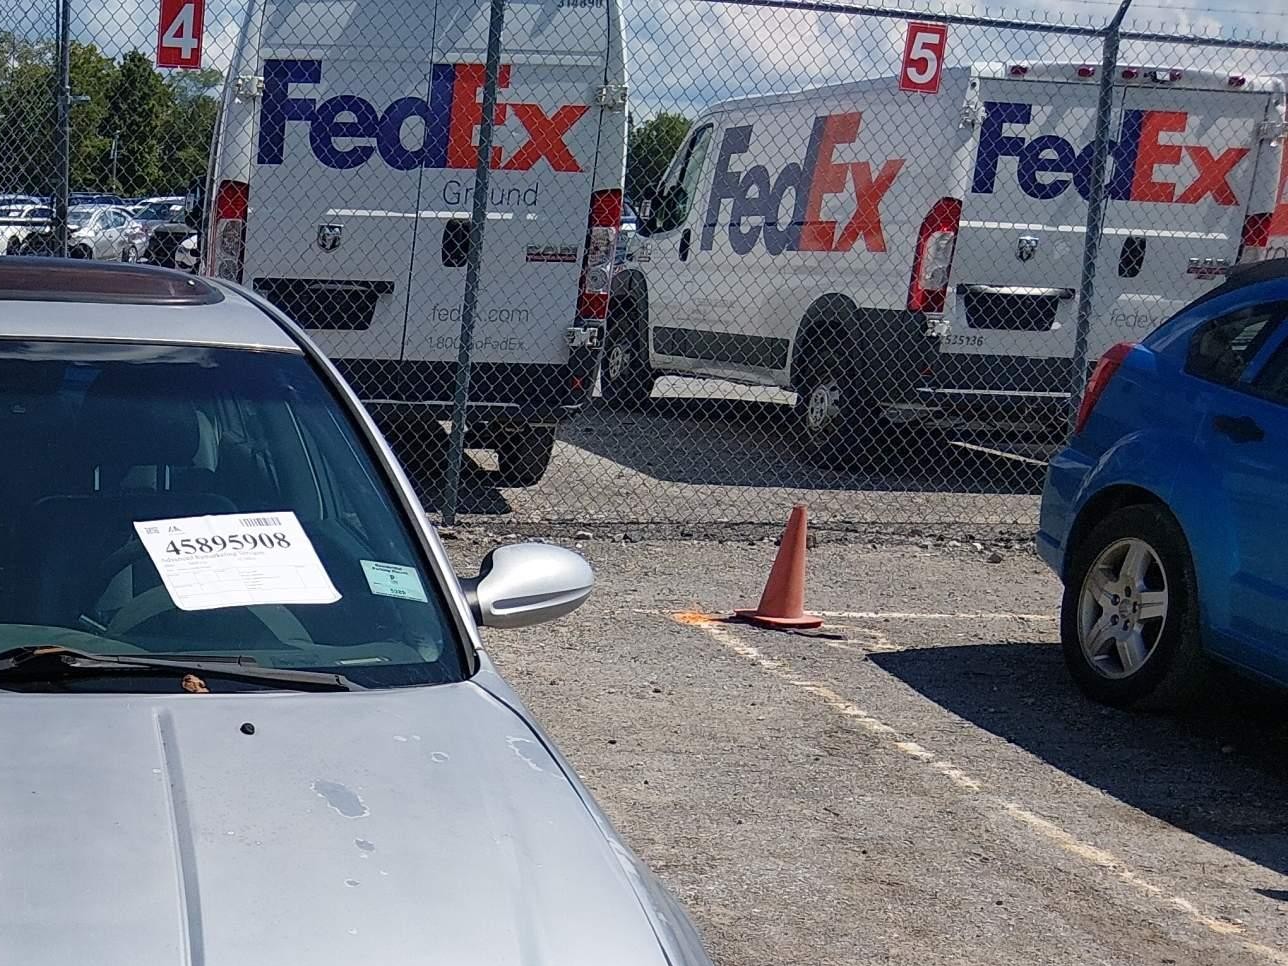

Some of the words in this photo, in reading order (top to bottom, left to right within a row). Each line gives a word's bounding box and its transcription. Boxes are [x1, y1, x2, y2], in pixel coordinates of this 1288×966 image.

[162, 3, 198, 59] 4
[906, 31, 941, 84] 5
[257, 59, 591, 172] FedEx
[971, 100, 1251, 206] FedEx
[442, 179, 540, 207] Grund
[700, 111, 907, 256] FedEx
[431, 303, 529, 322] fedx.com
[165, 532, 291, 555] 45895908
